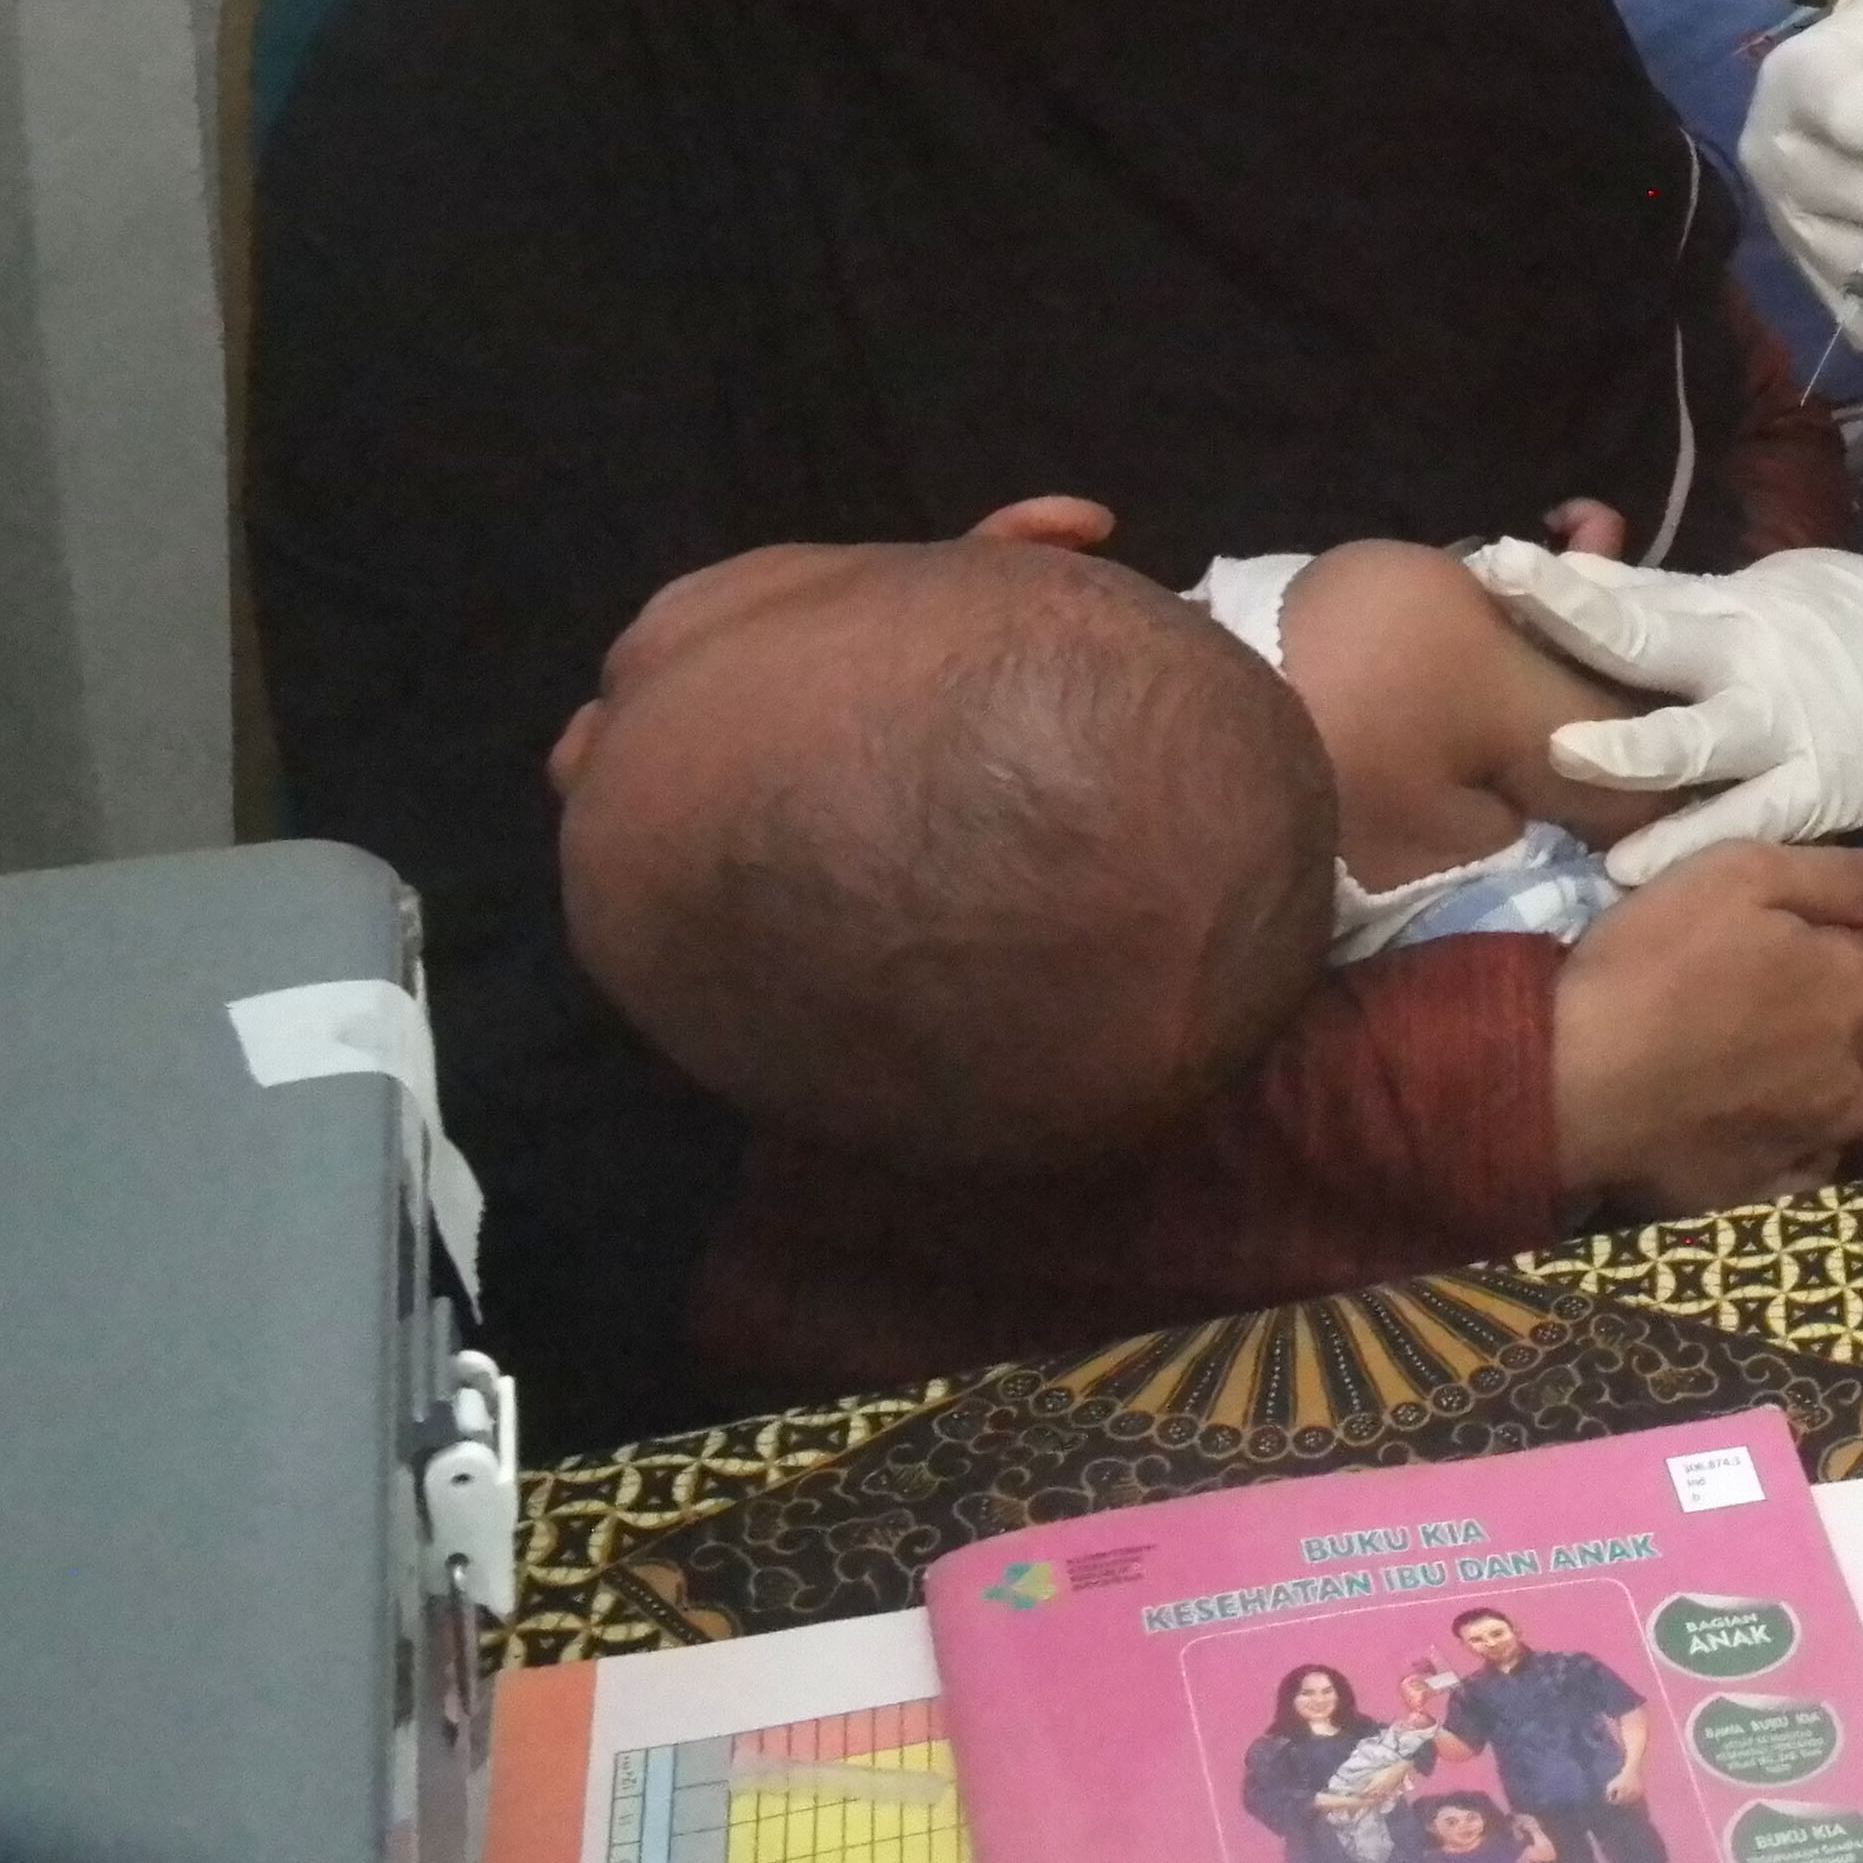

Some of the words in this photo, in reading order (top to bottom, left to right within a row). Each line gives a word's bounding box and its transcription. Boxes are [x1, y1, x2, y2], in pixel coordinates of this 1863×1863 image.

[1301, 1527, 1410, 1563] BUKU
[1419, 1518, 1490, 1549] KIA
[1142, 1570, 1374, 1633] KESEHATAN
[1380, 1561, 1448, 1592] IBU
[1456, 1550, 1542, 1582] DAN
[1550, 1533, 1663, 1572] ANAK
[1685, 1612, 1758, 1633] BAGIAN
[1689, 1624, 1772, 1655] ANAK
[1755, 1828, 1808, 1849] BUKU
[1811, 1822, 1848, 1839] KIA
